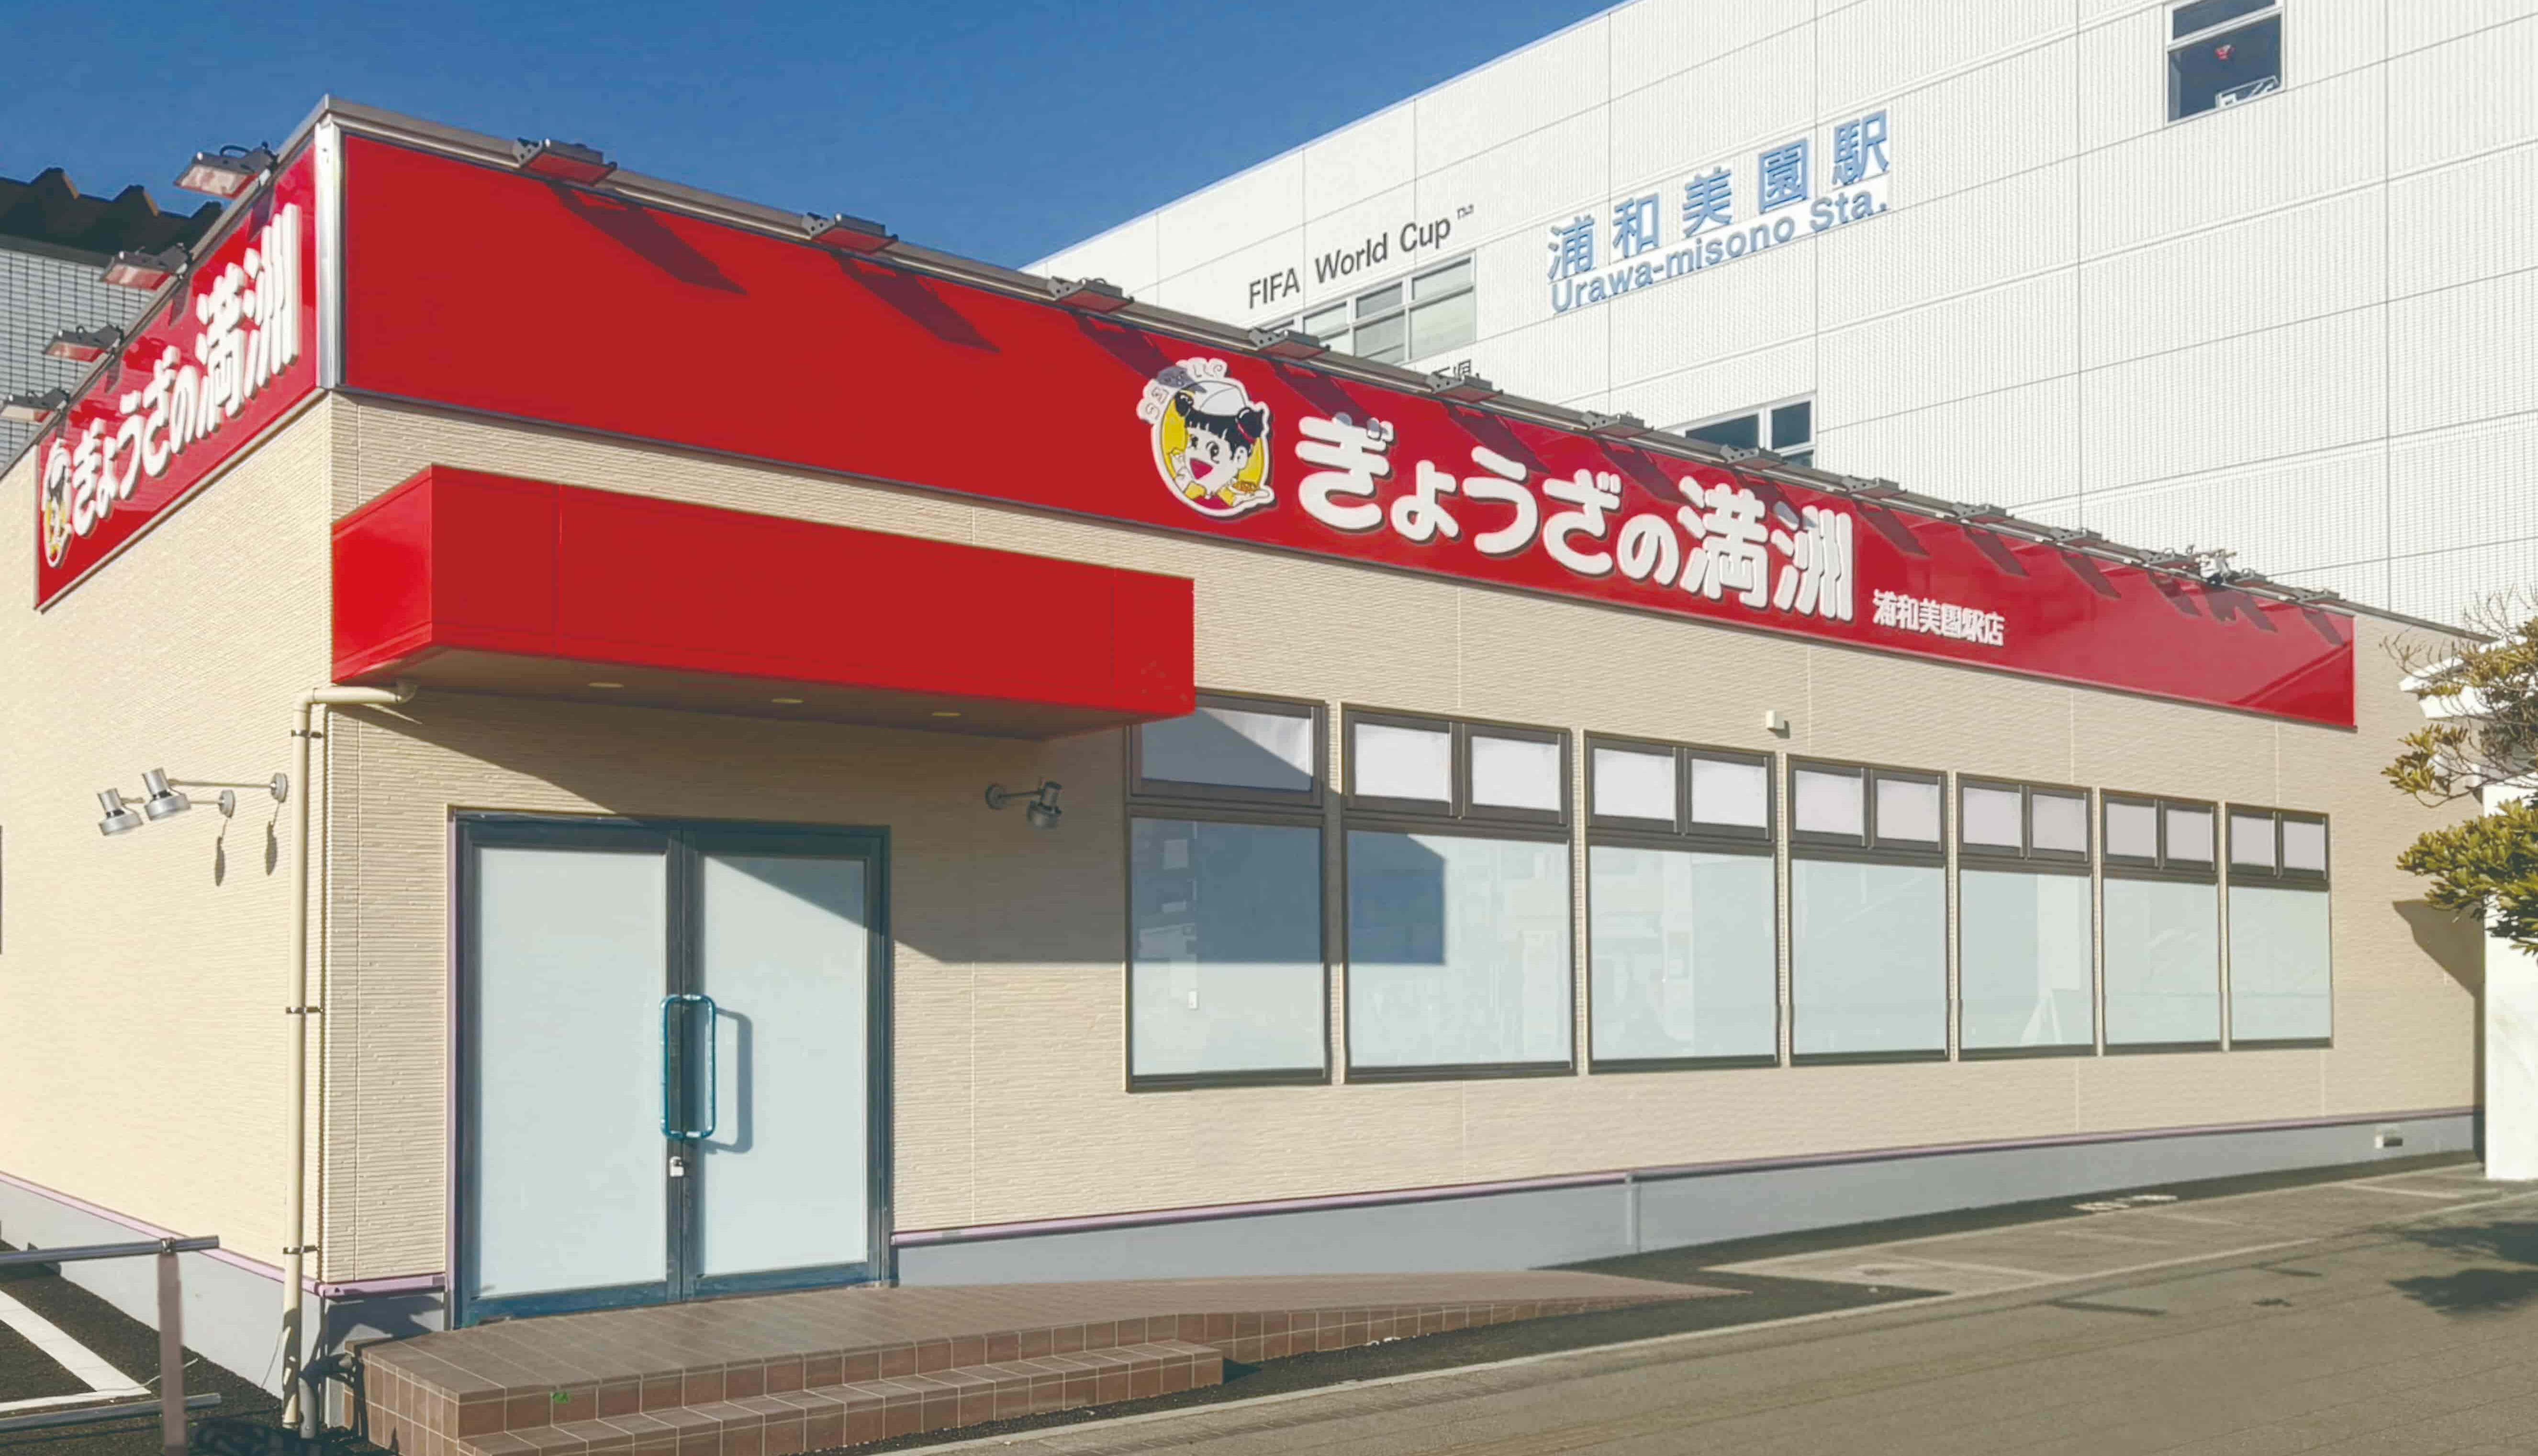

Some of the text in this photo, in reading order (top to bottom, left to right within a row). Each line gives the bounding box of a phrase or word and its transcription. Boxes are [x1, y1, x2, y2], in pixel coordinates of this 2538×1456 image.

[1249, 218, 1451, 309] FIFA World Cup
[1547, 109, 1890, 280] 浦和美園駅
[1552, 189, 1887, 312] Urawa-misono Sta.
[72, 202, 302, 536] ぎょうざの満洲
[1294, 412, 1854, 622] ぎょうざの満洲
[1872, 589, 2005, 646] 浦和美園駅店
